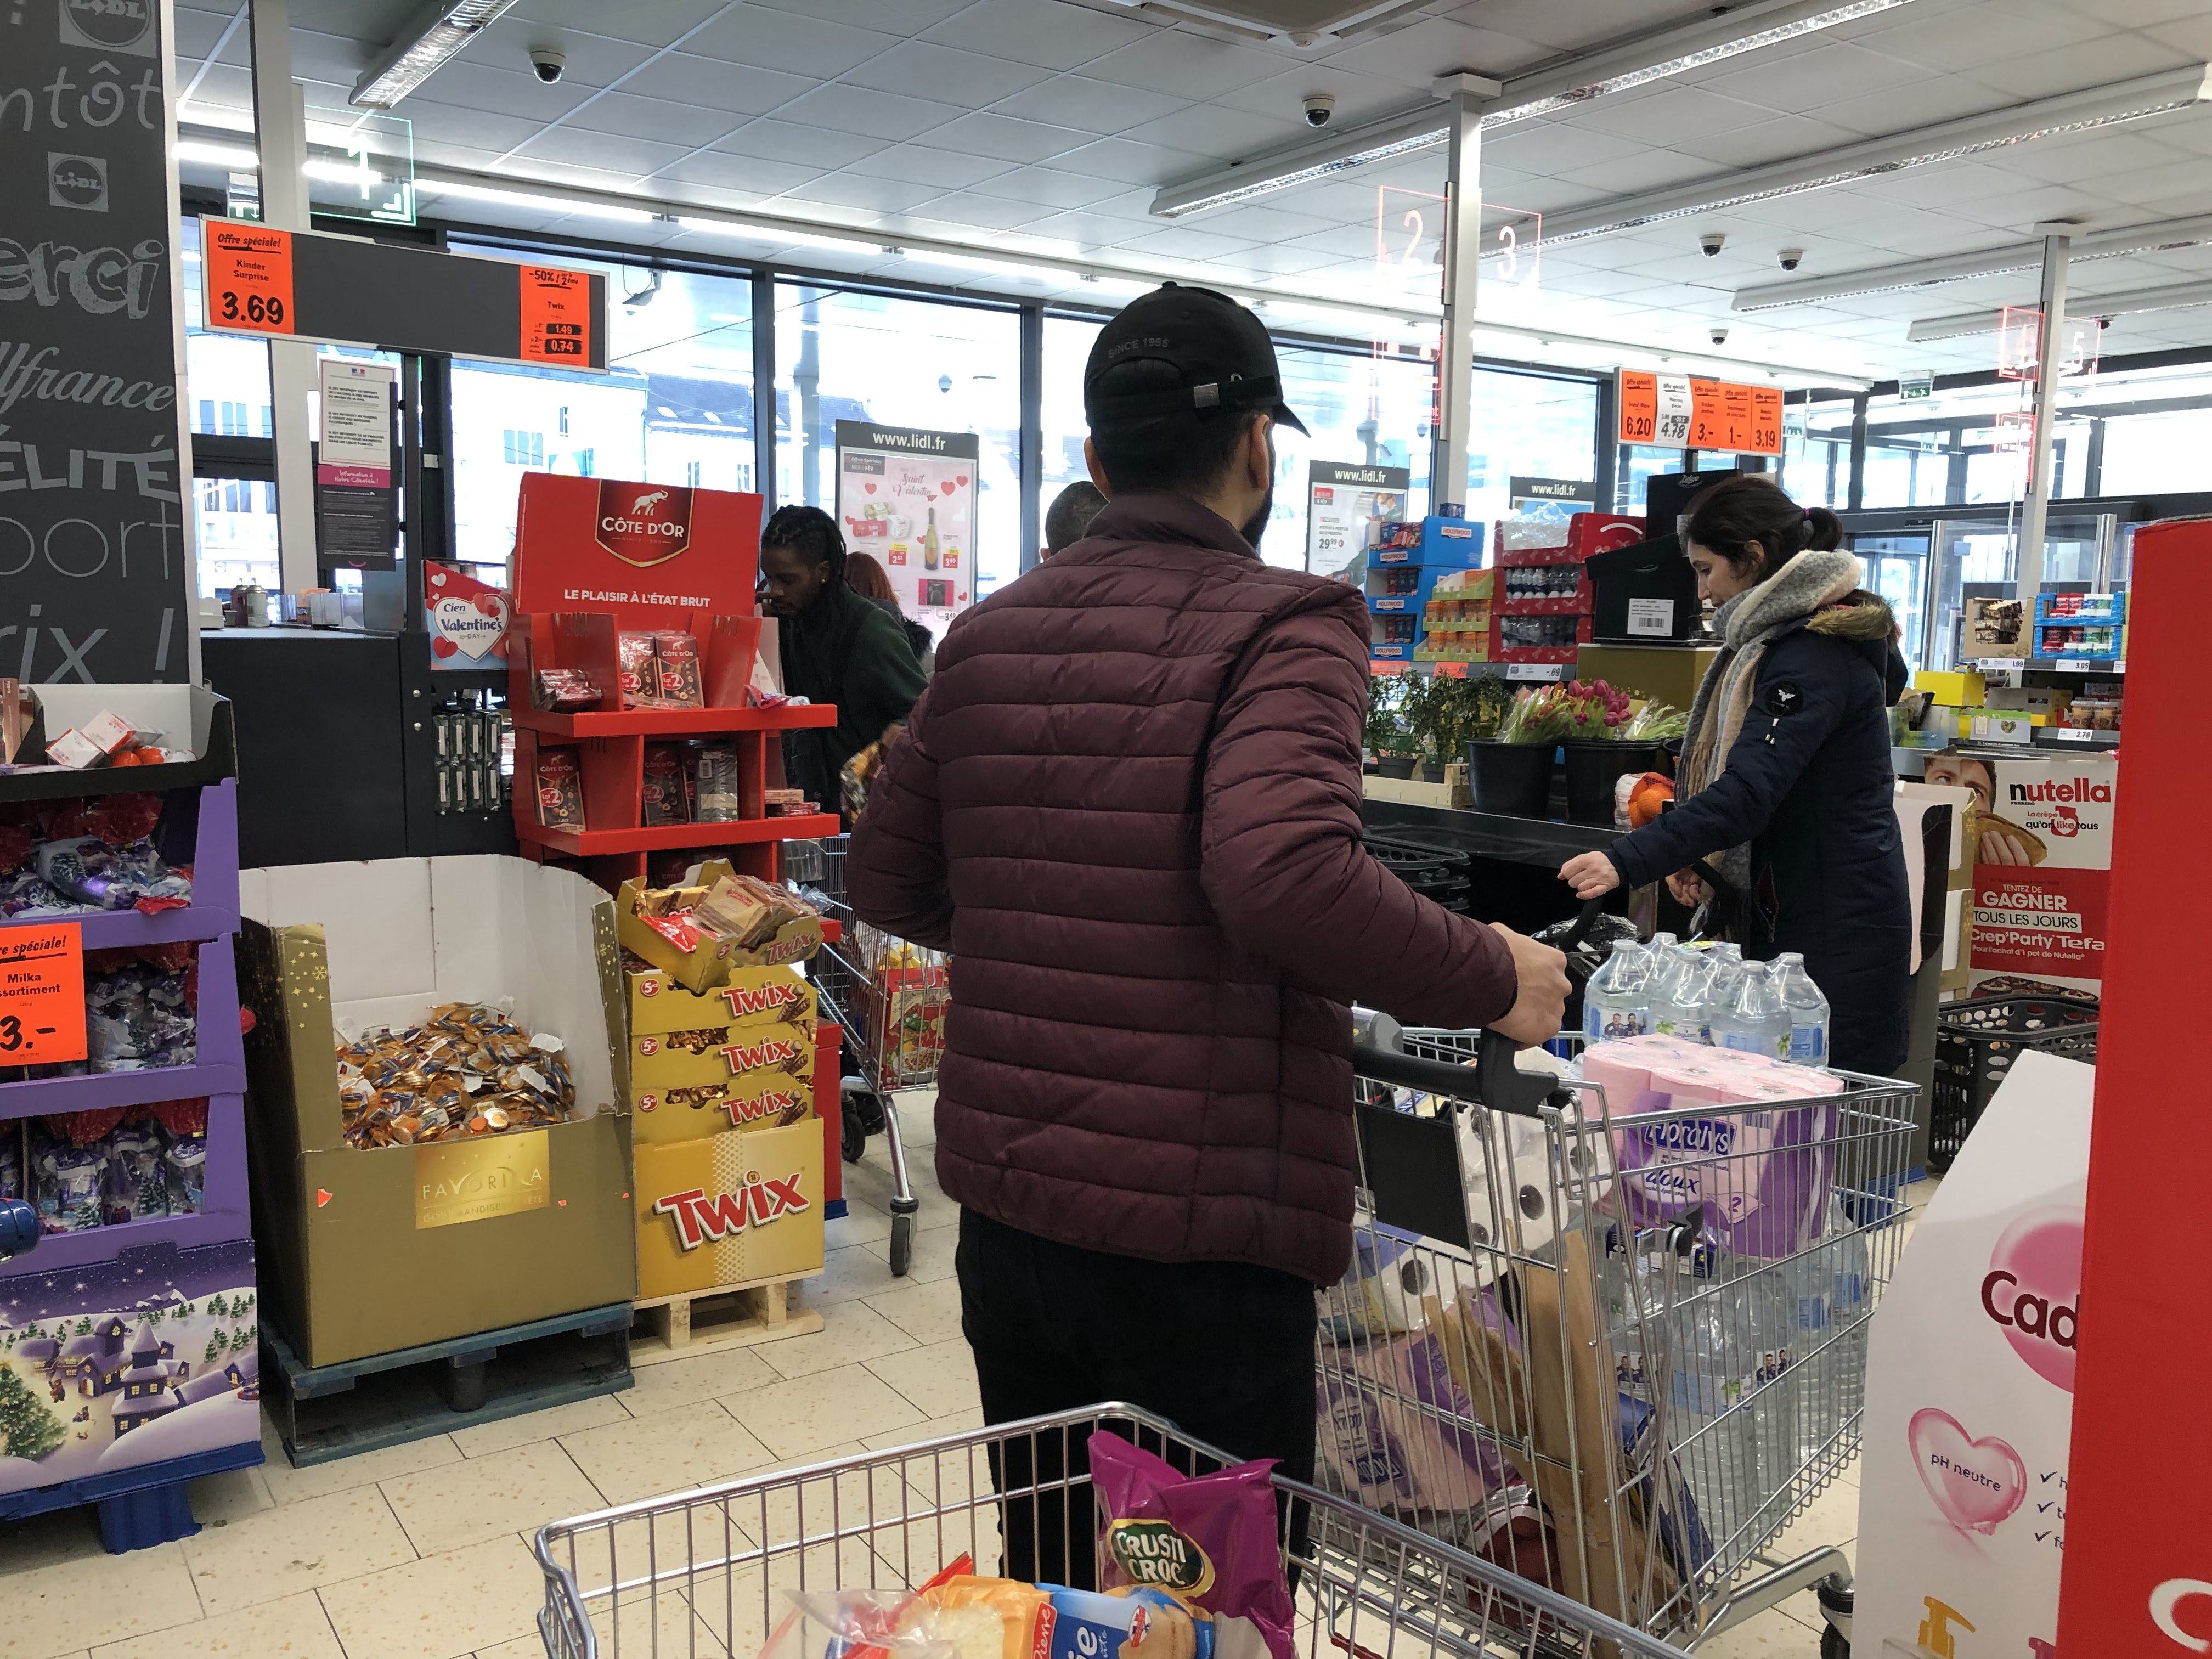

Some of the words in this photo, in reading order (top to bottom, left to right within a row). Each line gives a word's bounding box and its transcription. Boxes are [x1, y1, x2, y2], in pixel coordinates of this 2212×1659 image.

[218, 233, 240, 244] Offre
[243, 236, 281, 248] spéciale!
[1403, 210, 1423, 264] 2
[1497, 225, 1516, 279] 3
[236, 259, 266, 270] Kinder
[233, 269, 269, 281] Surprise
[529, 269, 554, 282] -50%
[222, 291, 284, 325] 3.69
[547, 301, 565, 310] Twix
[555, 324, 573, 334] 1.49
[551, 339, 574, 352] 0.74
[1108, 340, 1139, 358] SINCE
[1627, 416, 1651, 436] 6.20
[1661, 422, 1686, 439] 4.78
[1697, 422, 1714, 441] 3.-
[873, 433, 946, 450] www.lidl.fr
[1755, 429, 1775, 448] 3.19
[339, 470, 368, 478] Information
[900, 472, 926, 486] Saint
[1334, 469, 1386, 483] www.lidl.fr
[892, 484, 932, 497] Valentin
[1531, 483, 1576, 496] www.lidl.fr
[602, 516, 644, 534] CÔTE
[648, 522, 684, 538] D'OR
[1443, 528, 1471, 536] HOLLYWOOD
[564, 589, 579, 600] LE
[581, 590, 628, 603] PLAISIR
[630, 590, 640, 603] À
[641, 592, 679, 606] L'ÉTAT
[680, 596, 711, 607] BRUT
[443, 603, 466, 612] Cien
[441, 617, 503, 632] Valentine's
[1546, 667, 1560, 677] -.69
[671, 675, 681, 687] 2
[550, 791, 560, 804] 2
[2009, 777, 2112, 803] nutella
[2057, 821, 2075, 830] like
[2077, 822, 2099, 830] tous
[2003, 884, 2029, 893] TENTEZ
[1982, 891, 2068, 911] GAGNER
[1974, 911, 2006, 924] TOUS
[2010, 913, 2029, 925] LES
[2033, 915, 2078, 929] JOURS
[13, 935, 67, 956] spéciale!
[1972, 945, 1988, 953] Pour
[1988, 946, 2014, 955] l'achat
[7, 973, 41, 983] Milka
[0, 1015, 57, 1051] 3.-
[1646, 1169, 1700, 1194] doux
[1930, 1452, 1949, 1469] pH
[1954, 1462, 2001, 1492] neutre
[1115, 1531, 1186, 1563] CRUSTI
[1128, 1558, 1186, 1585] CROC
